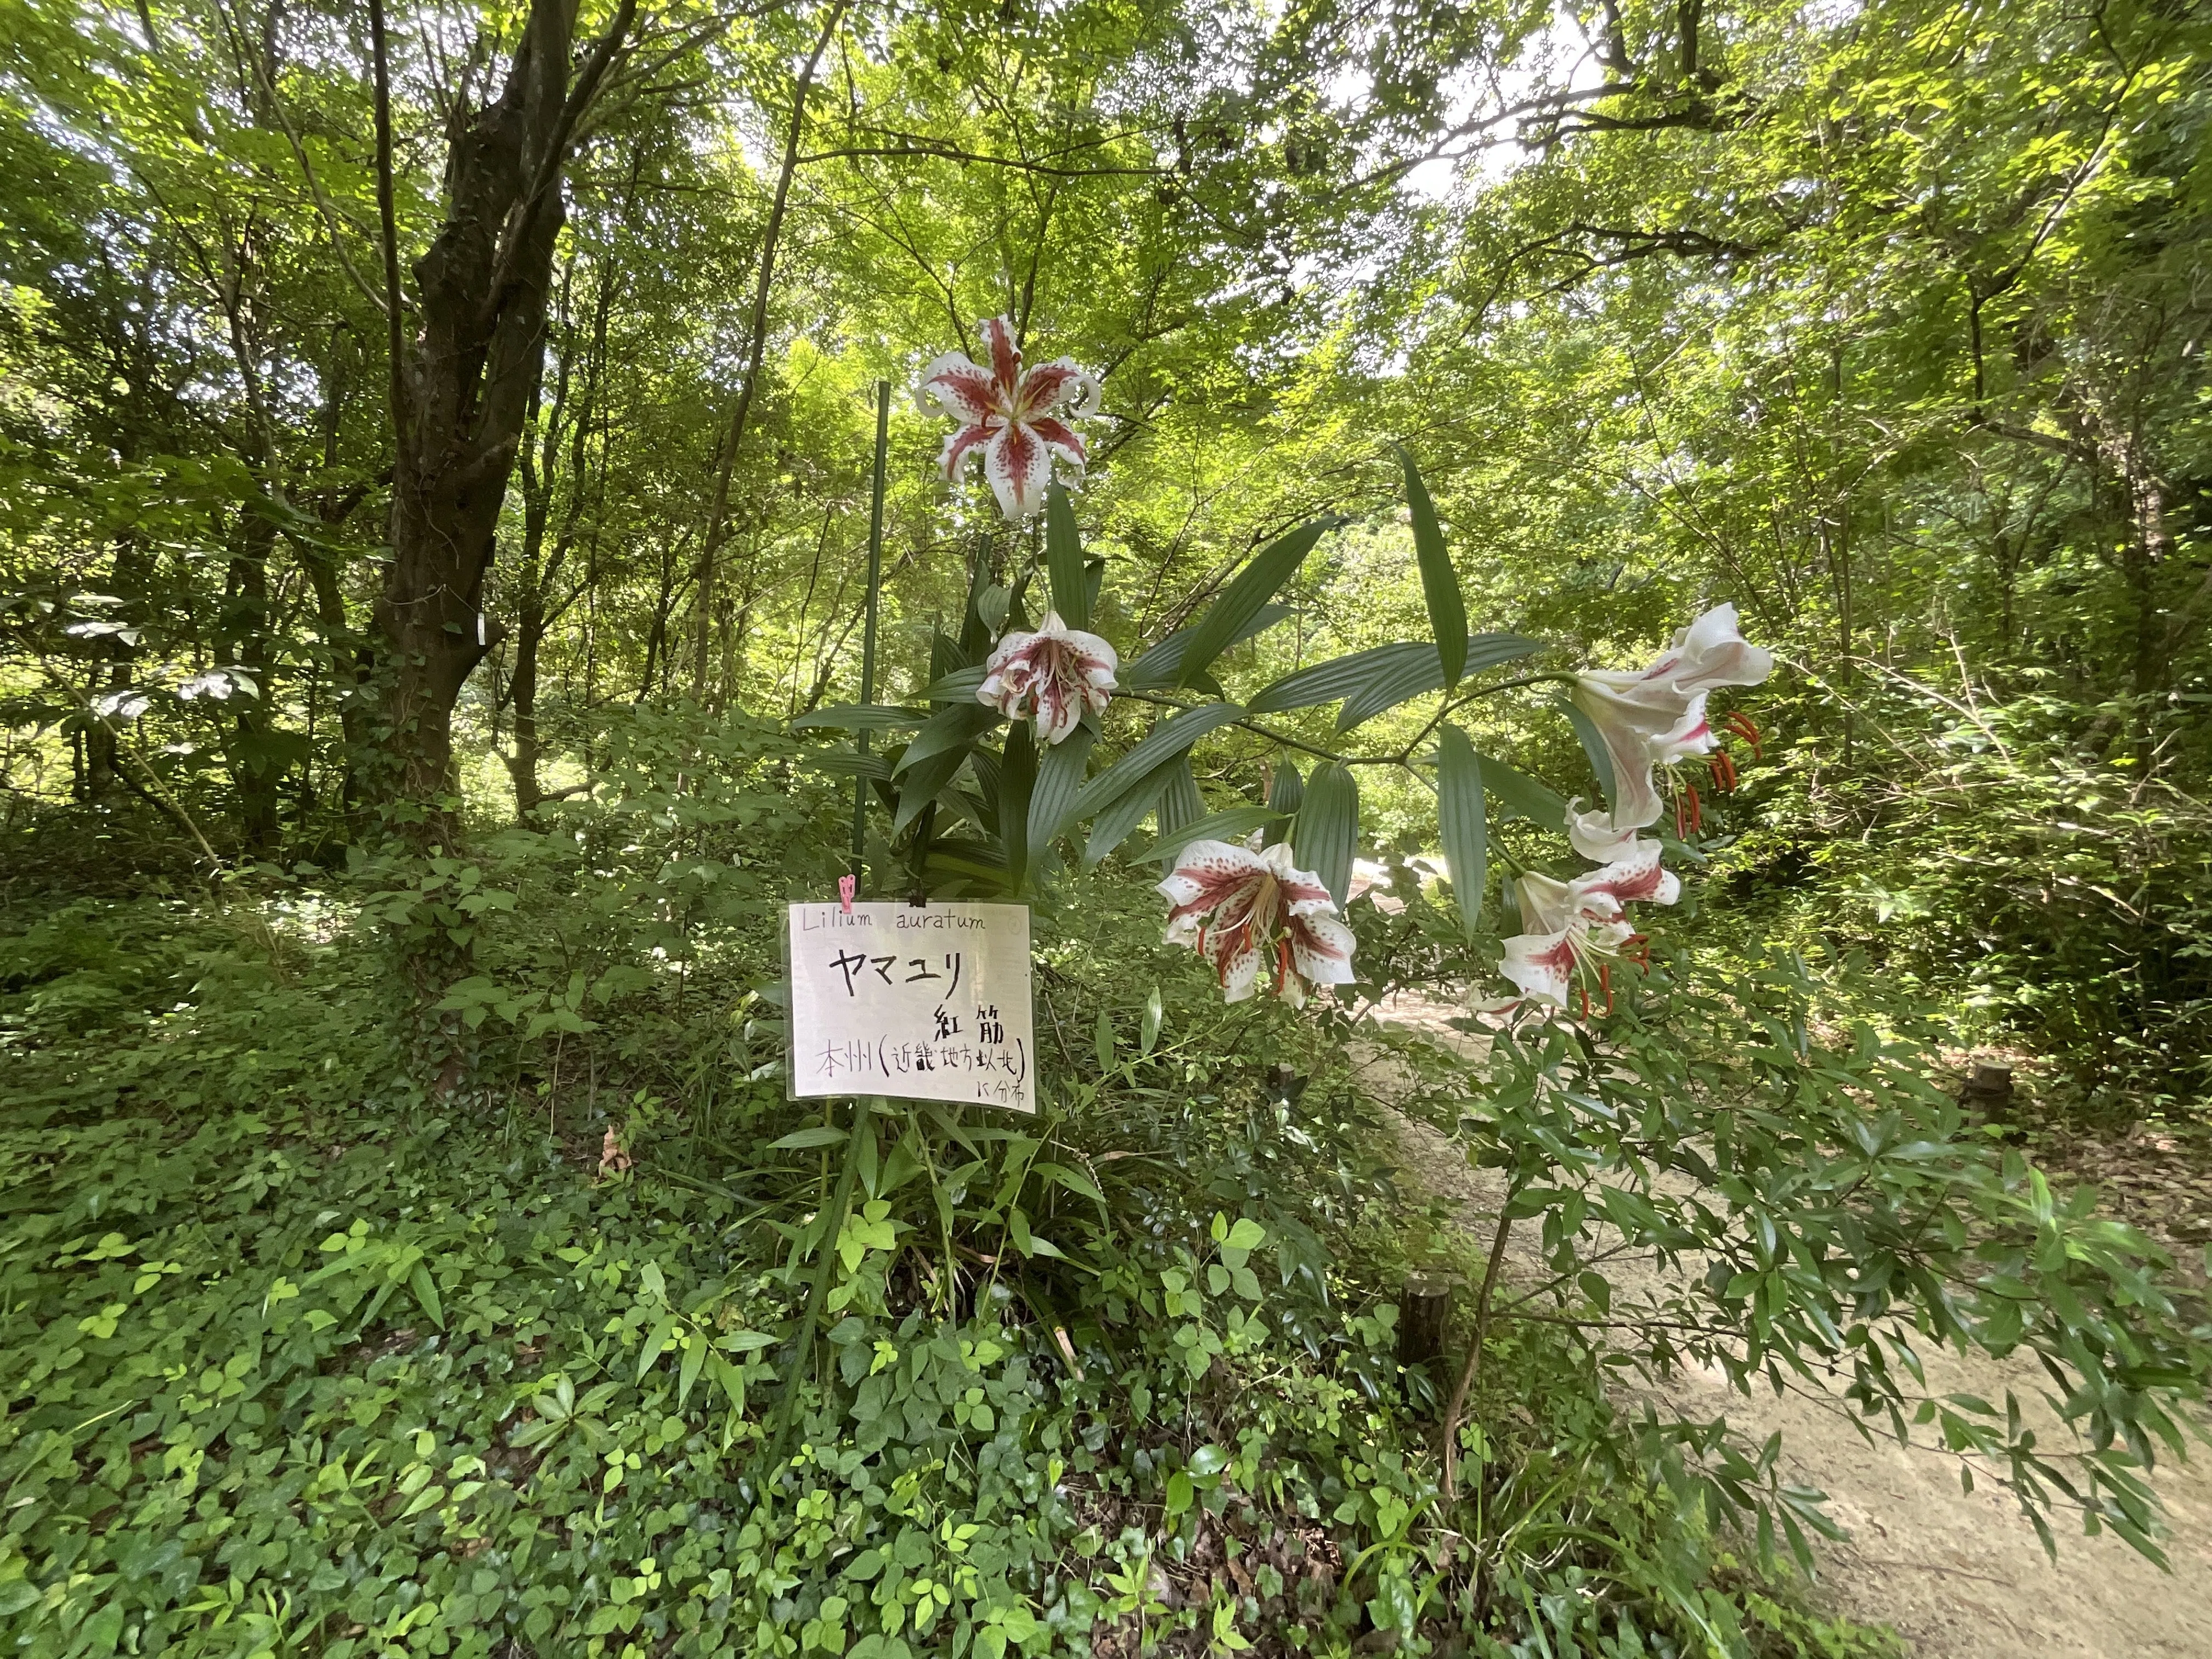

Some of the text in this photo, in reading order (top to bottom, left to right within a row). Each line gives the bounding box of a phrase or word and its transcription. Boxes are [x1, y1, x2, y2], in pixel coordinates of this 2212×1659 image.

[803, 906, 872, 930] Lilium
[896, 909, 986, 930] auratum
[829, 950, 961, 1000] ヤマユリ
[978, 1080, 1025, 1108] に分布
